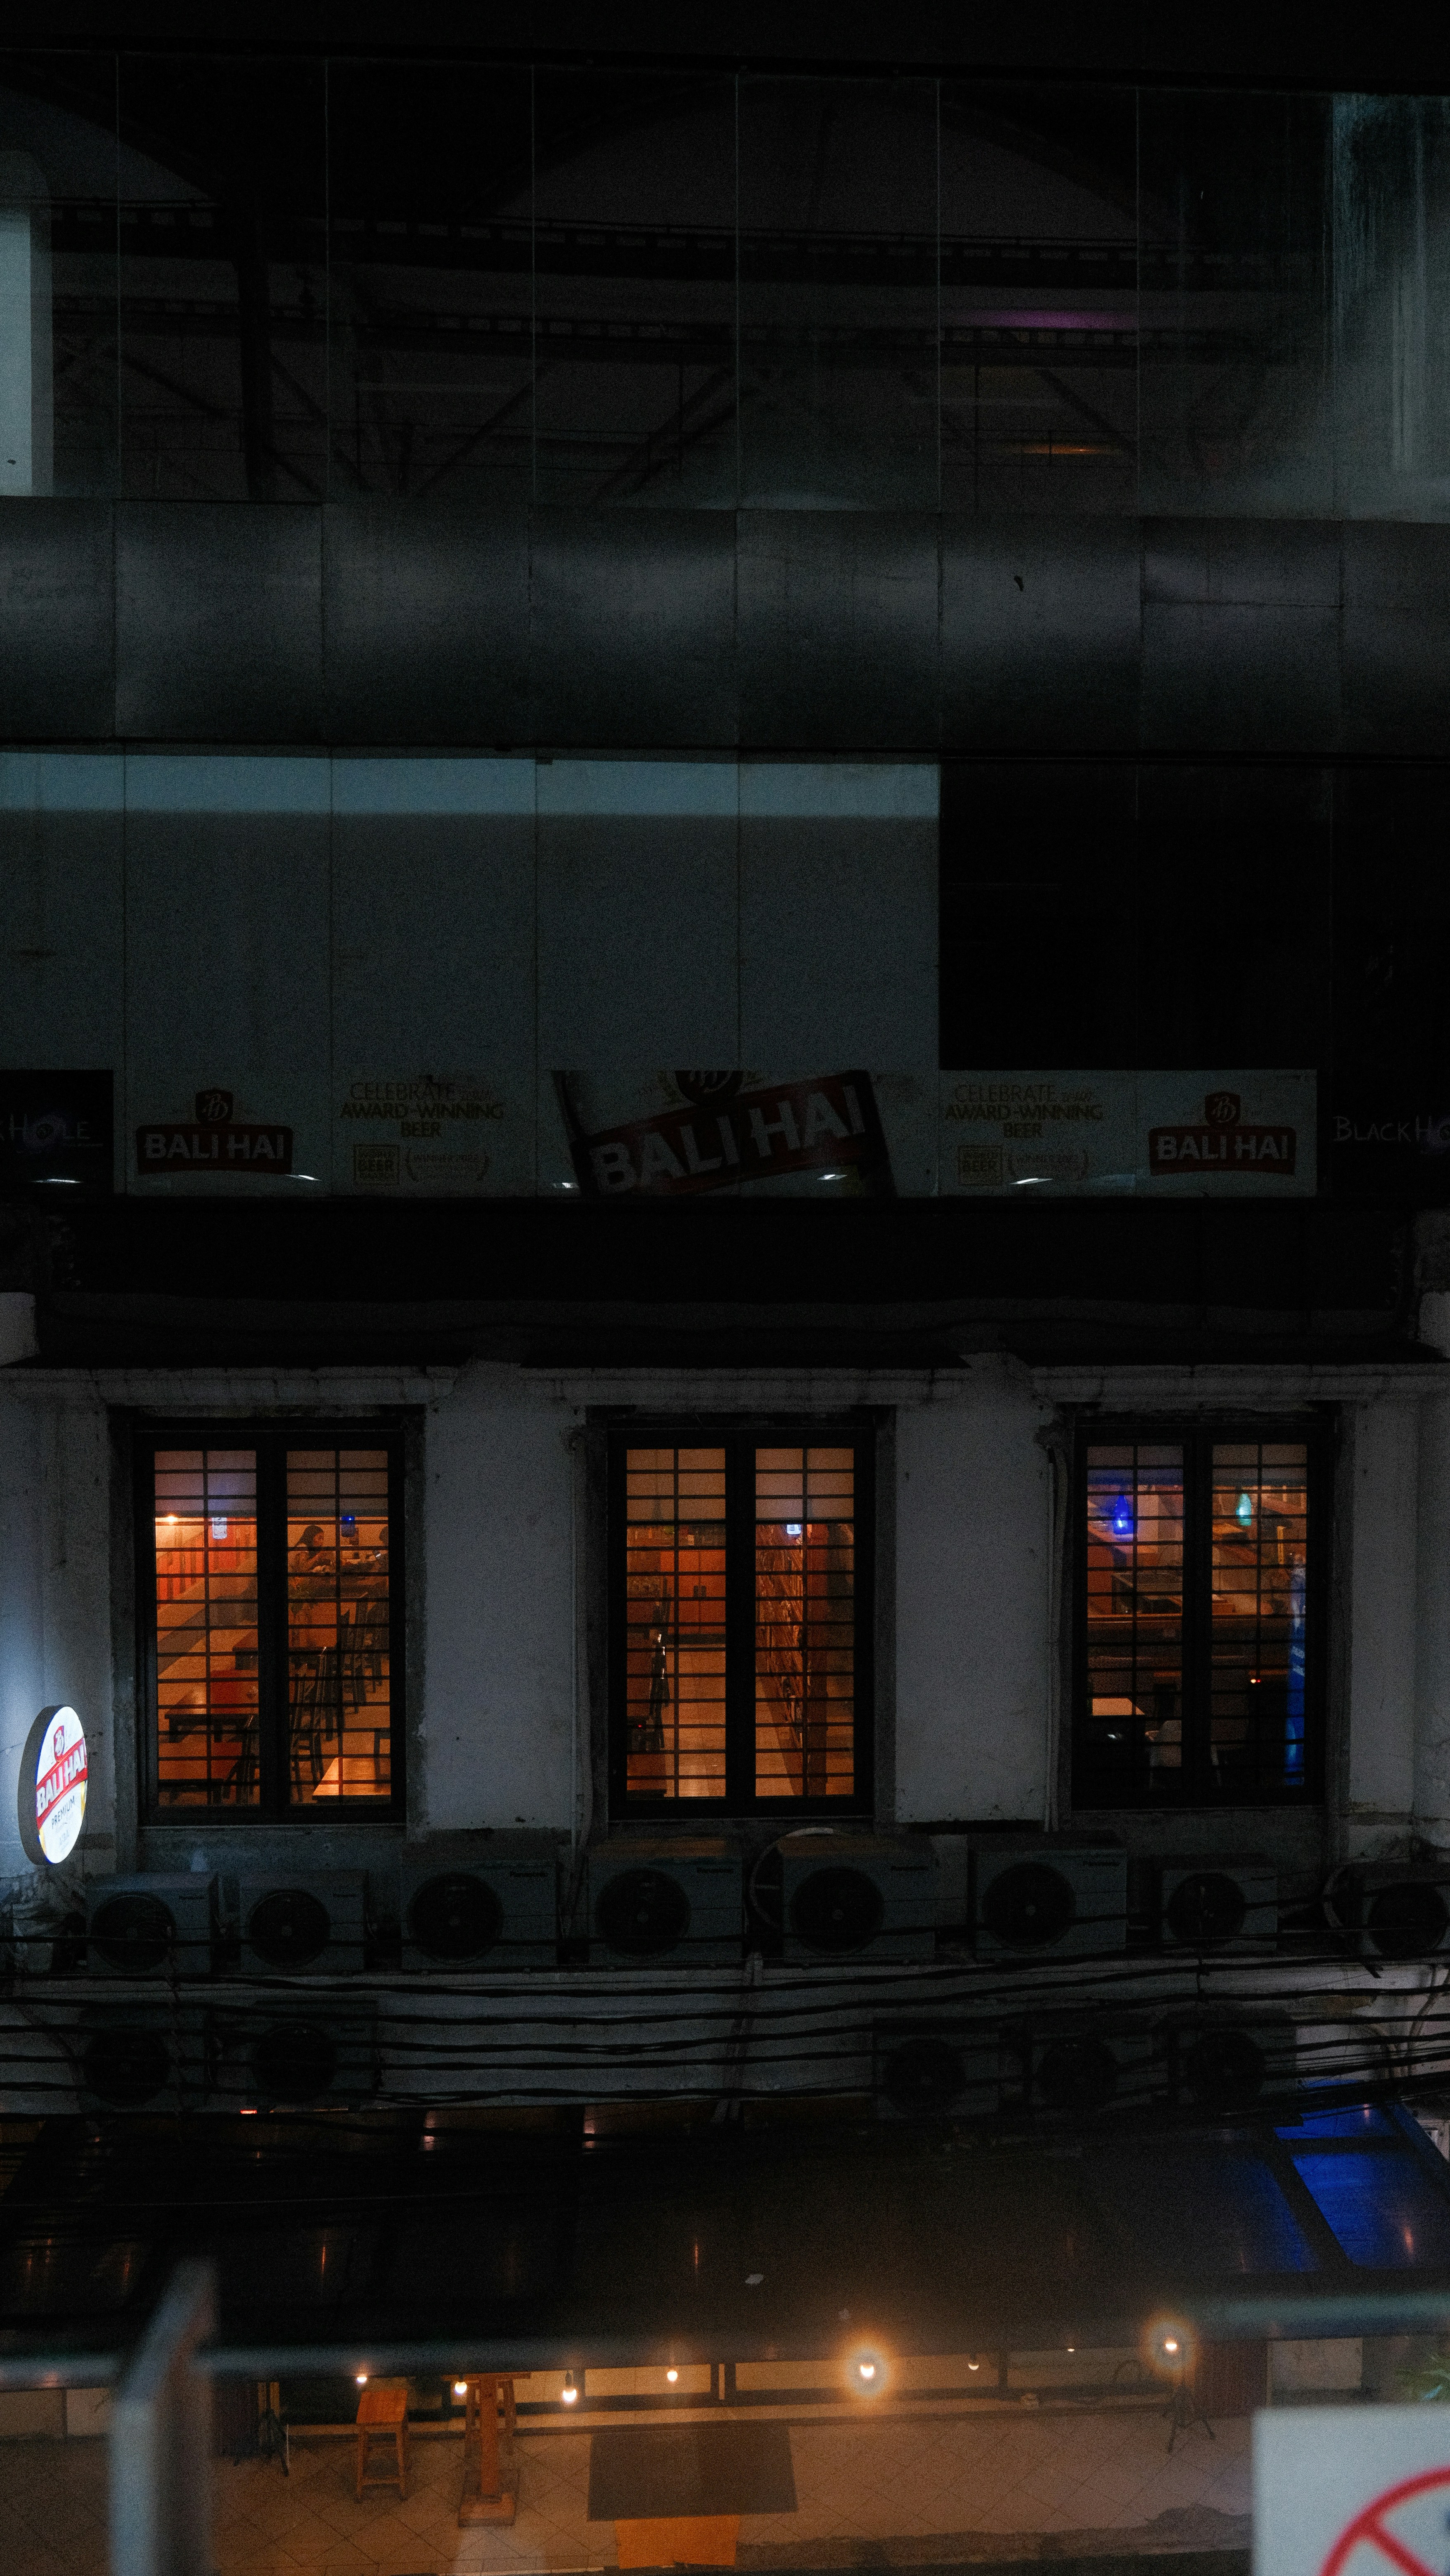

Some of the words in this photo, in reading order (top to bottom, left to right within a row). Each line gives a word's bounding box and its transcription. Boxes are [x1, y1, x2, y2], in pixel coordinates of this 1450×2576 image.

[955, 1084, 1056, 1102] CELEBRATE
[340, 1102, 504, 1120] AWARD-WINNING
[945, 1103, 1104, 1120] AWARD-WINNING
[400, 1121, 441, 1137] BEER
[1003, 1122, 1043, 1138] BEER
[145, 1133, 219, 1159] BALI
[228, 1133, 284, 1159] HAI
[589, 1115, 742, 1195] BALI
[749, 1085, 865, 1158] HAI
[1156, 1136, 1227, 1160] BALI
[1236, 1135, 1288, 1160] HAI
[36, 1766, 64, 1817] BALI
[63, 1743, 85, 1786] HAI
[51, 1797, 76, 1830] PREMIUM
